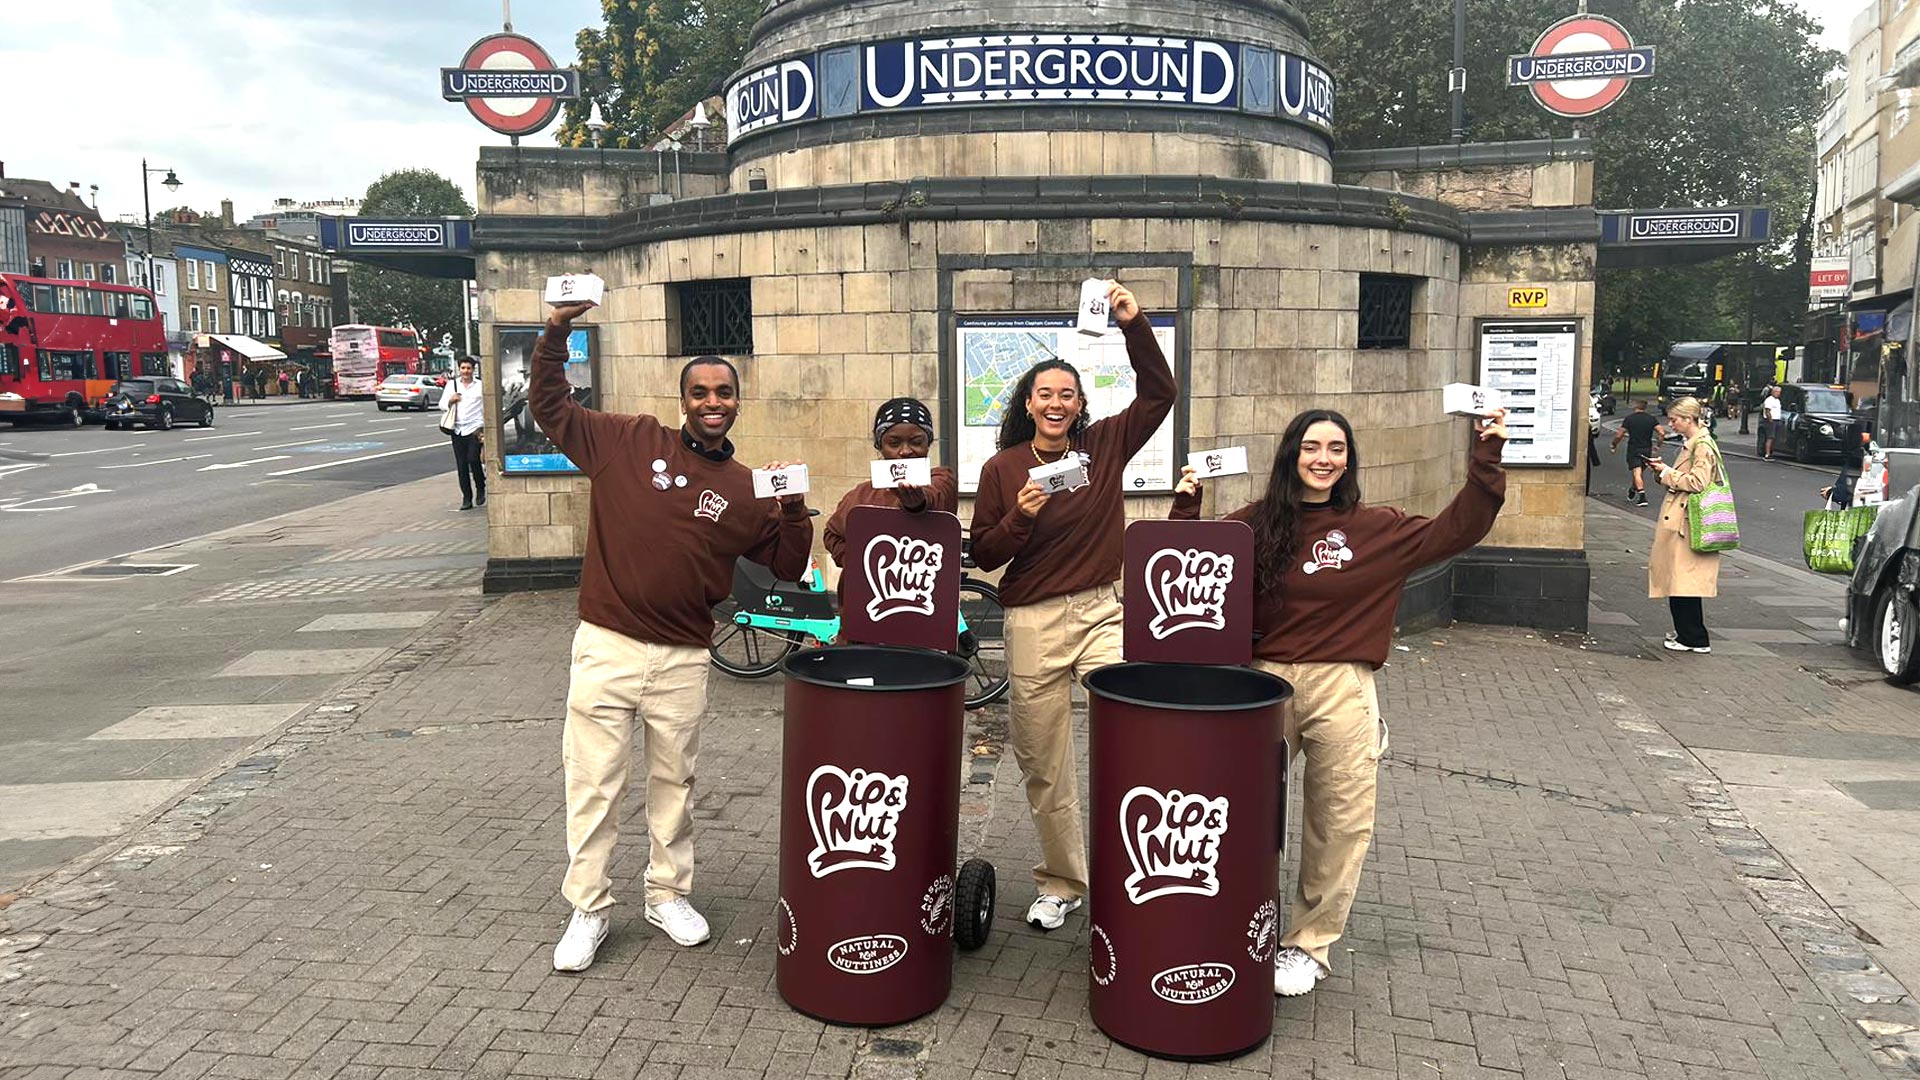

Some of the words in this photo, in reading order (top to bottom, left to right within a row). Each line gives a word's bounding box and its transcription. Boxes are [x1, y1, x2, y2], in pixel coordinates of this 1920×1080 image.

[866, 40, 1234, 107] UNDERGROUND
[1517, 53, 1646, 80] UNDERGROUND
[449, 74, 567, 93] UNDERGROUND
[1280, 54, 1334, 118] UNDE
[353, 227, 439, 242] UNDERGROUND
[1635, 218, 1734, 236] UNDERGROUND
[1817, 274, 1833, 282] LET
[1512, 291, 1545, 304] RVP
[884, 566, 933, 597] Nut
[1168, 580, 1222, 613] Nut
[828, 808, 894, 848] Nut
[1146, 831, 1215, 873] Nut
[838, 939, 895, 956] NATURAL
[835, 949, 901, 970] NUTTINESS
[1163, 967, 1222, 985] NATURAL
[1160, 978, 1229, 1000] NUTTINESS
